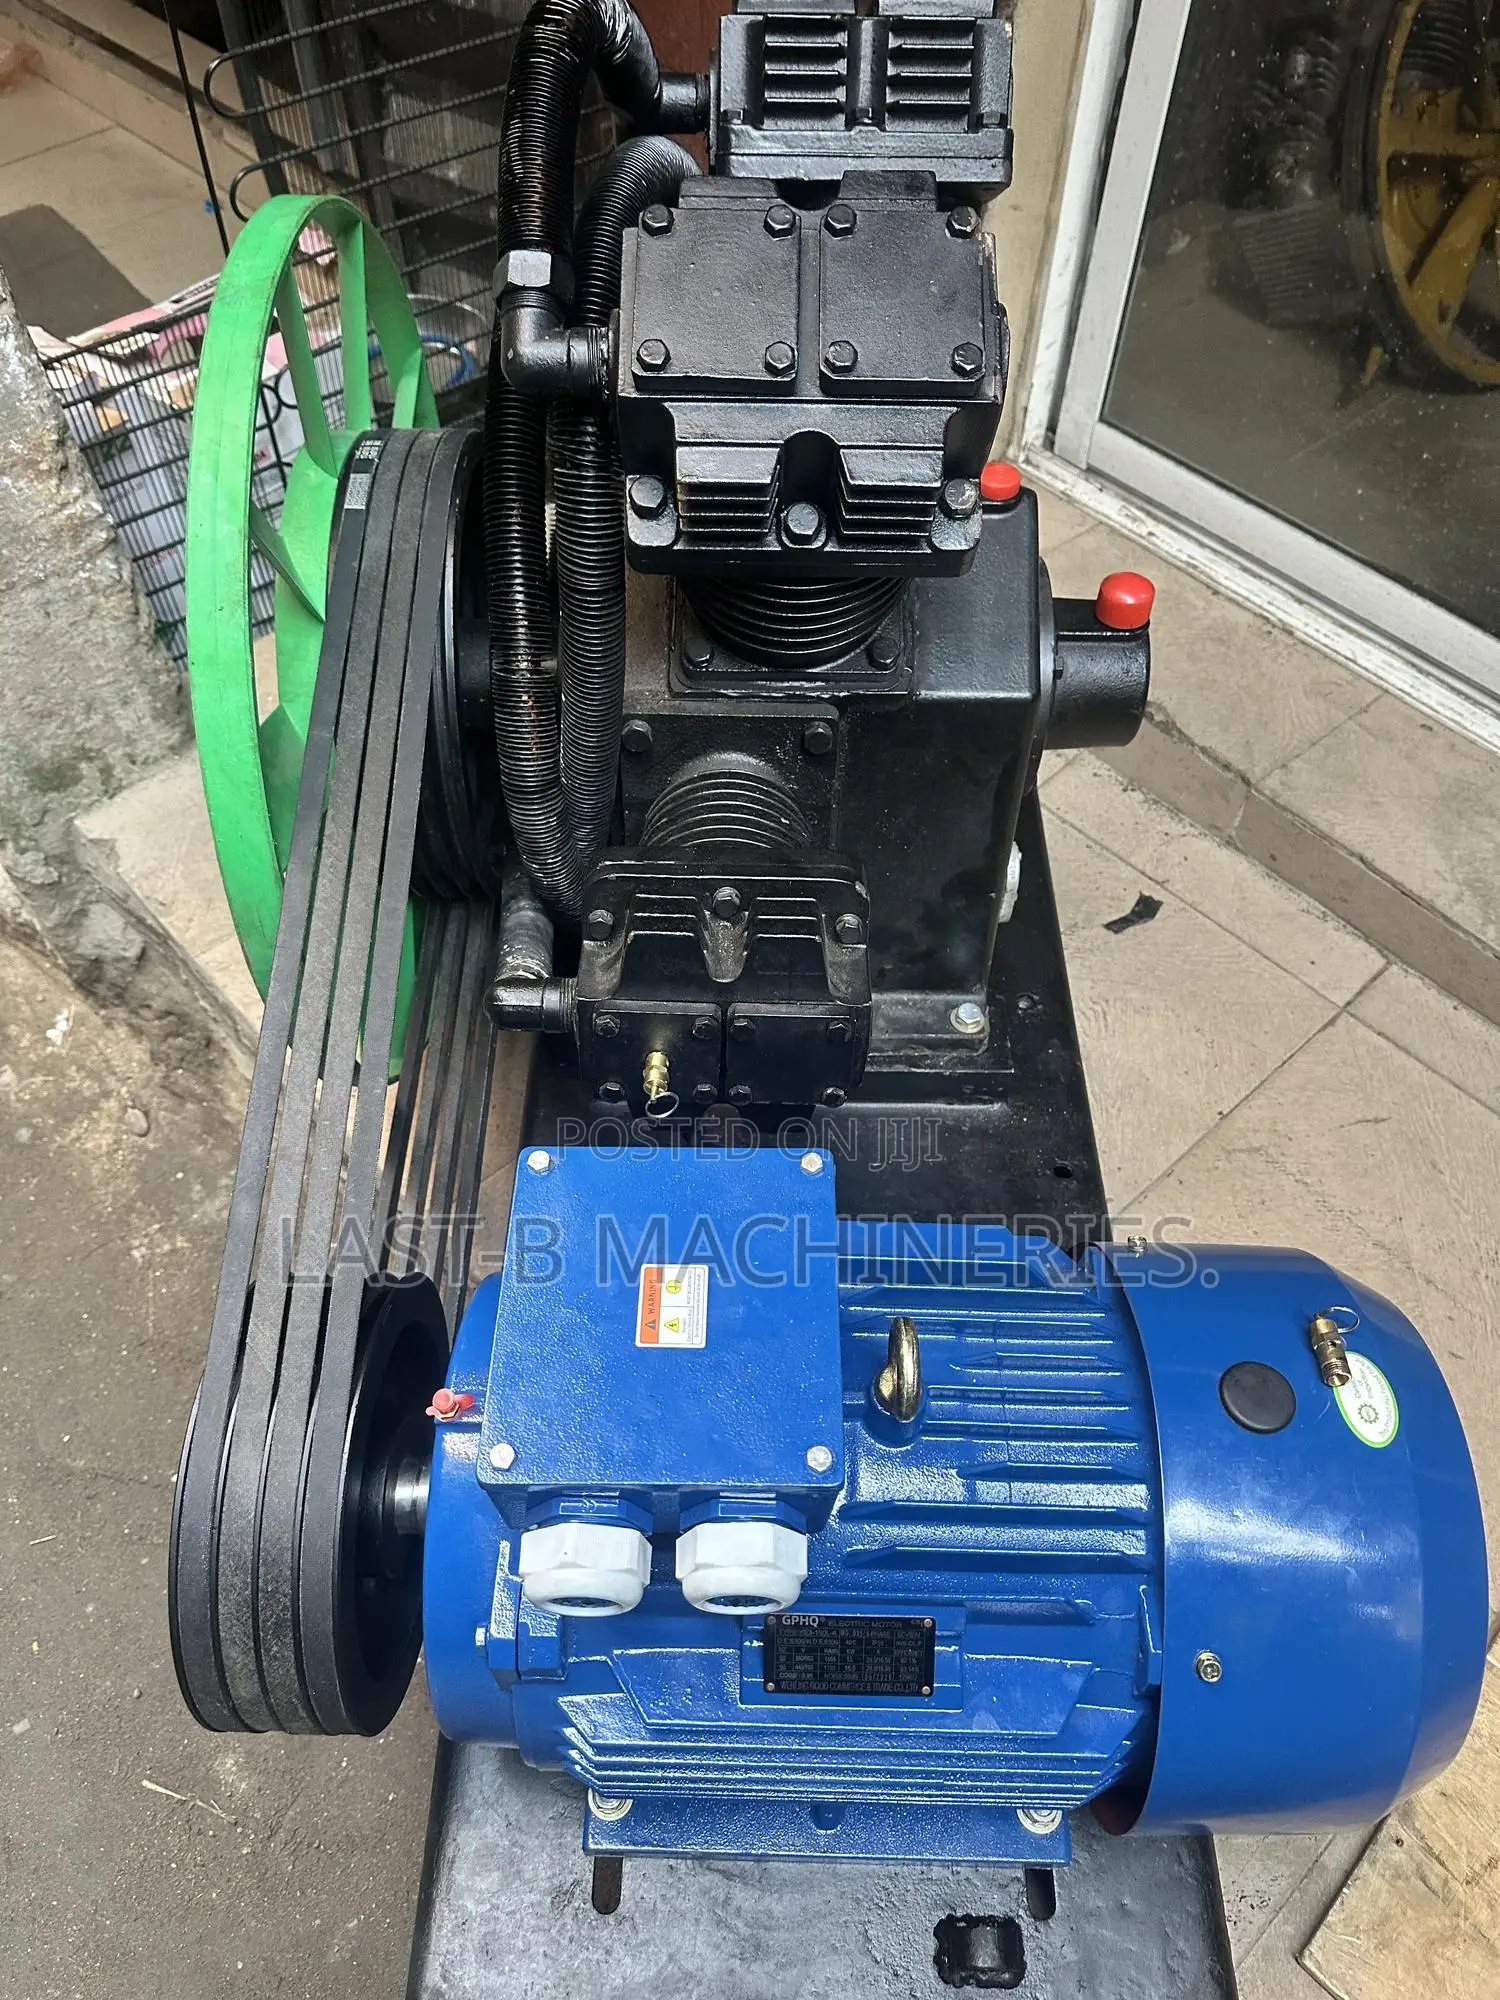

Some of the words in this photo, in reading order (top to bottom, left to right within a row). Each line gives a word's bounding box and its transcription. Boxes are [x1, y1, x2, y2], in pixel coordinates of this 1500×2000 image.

[648, 1279, 657, 1315] WARNING
[828, 1620, 870, 1628] ELECTRIC
[871, 1620, 903, 1629] MOTOR
